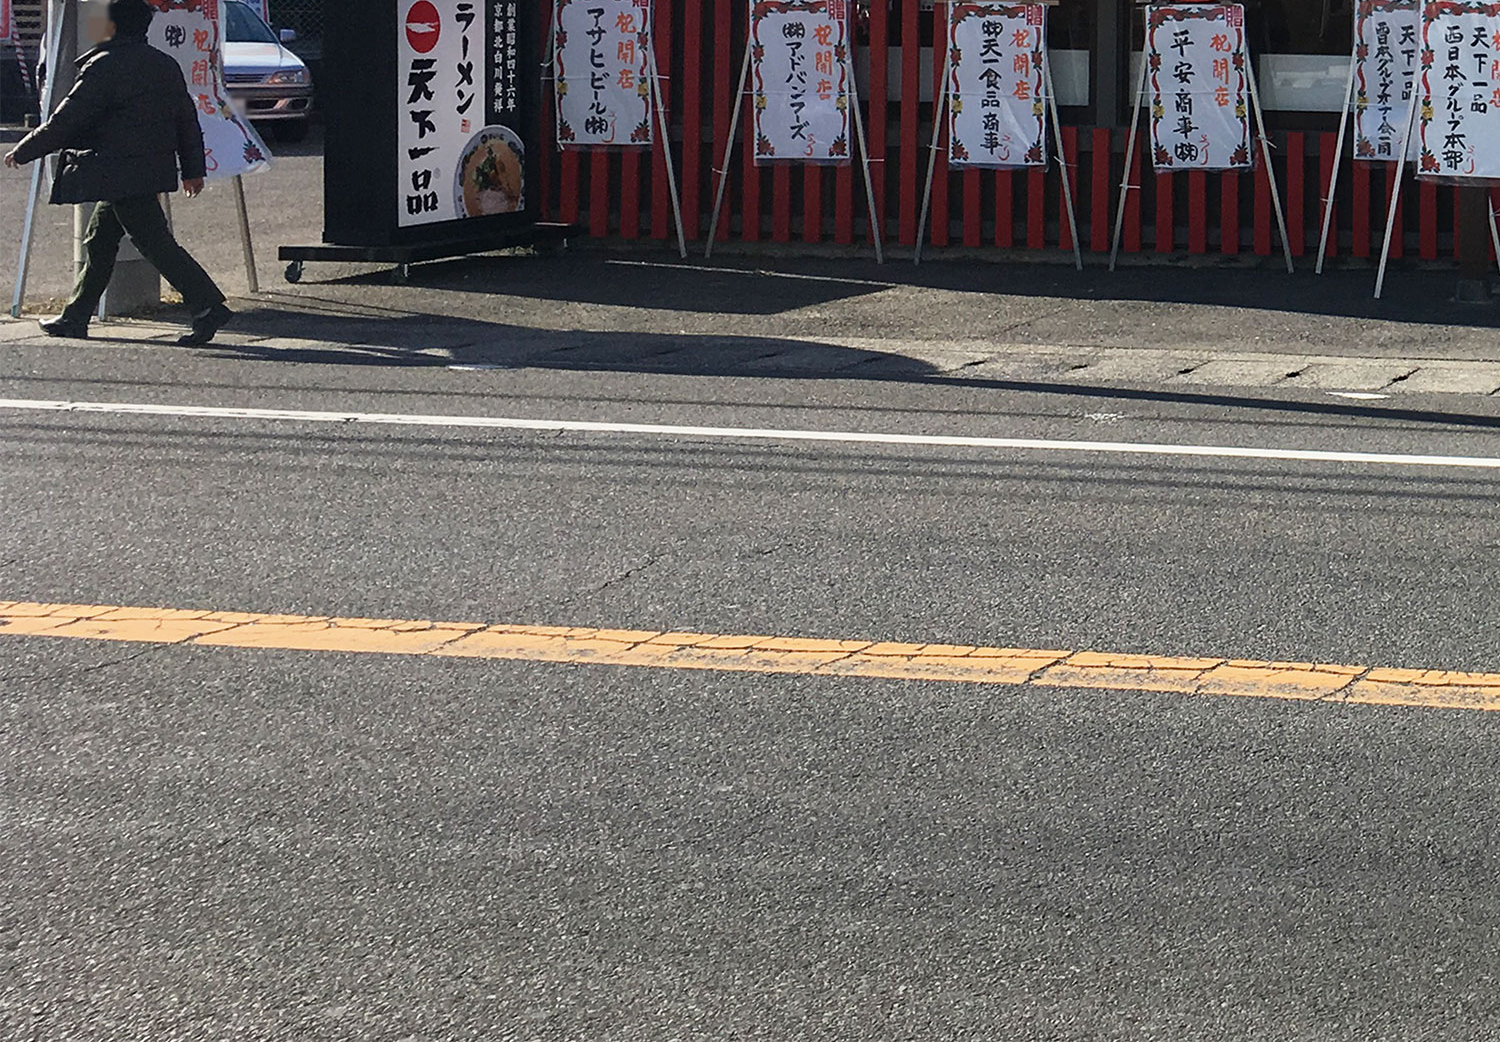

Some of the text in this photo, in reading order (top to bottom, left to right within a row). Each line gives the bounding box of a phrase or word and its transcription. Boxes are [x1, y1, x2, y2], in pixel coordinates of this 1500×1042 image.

[455, 4, 475, 114] ラーメン
[1443, 25, 1467, 171] 西日本グループ本部
[1470, 26, 1490, 114] 天下一品
[407, 59, 440, 215] 天下一品
